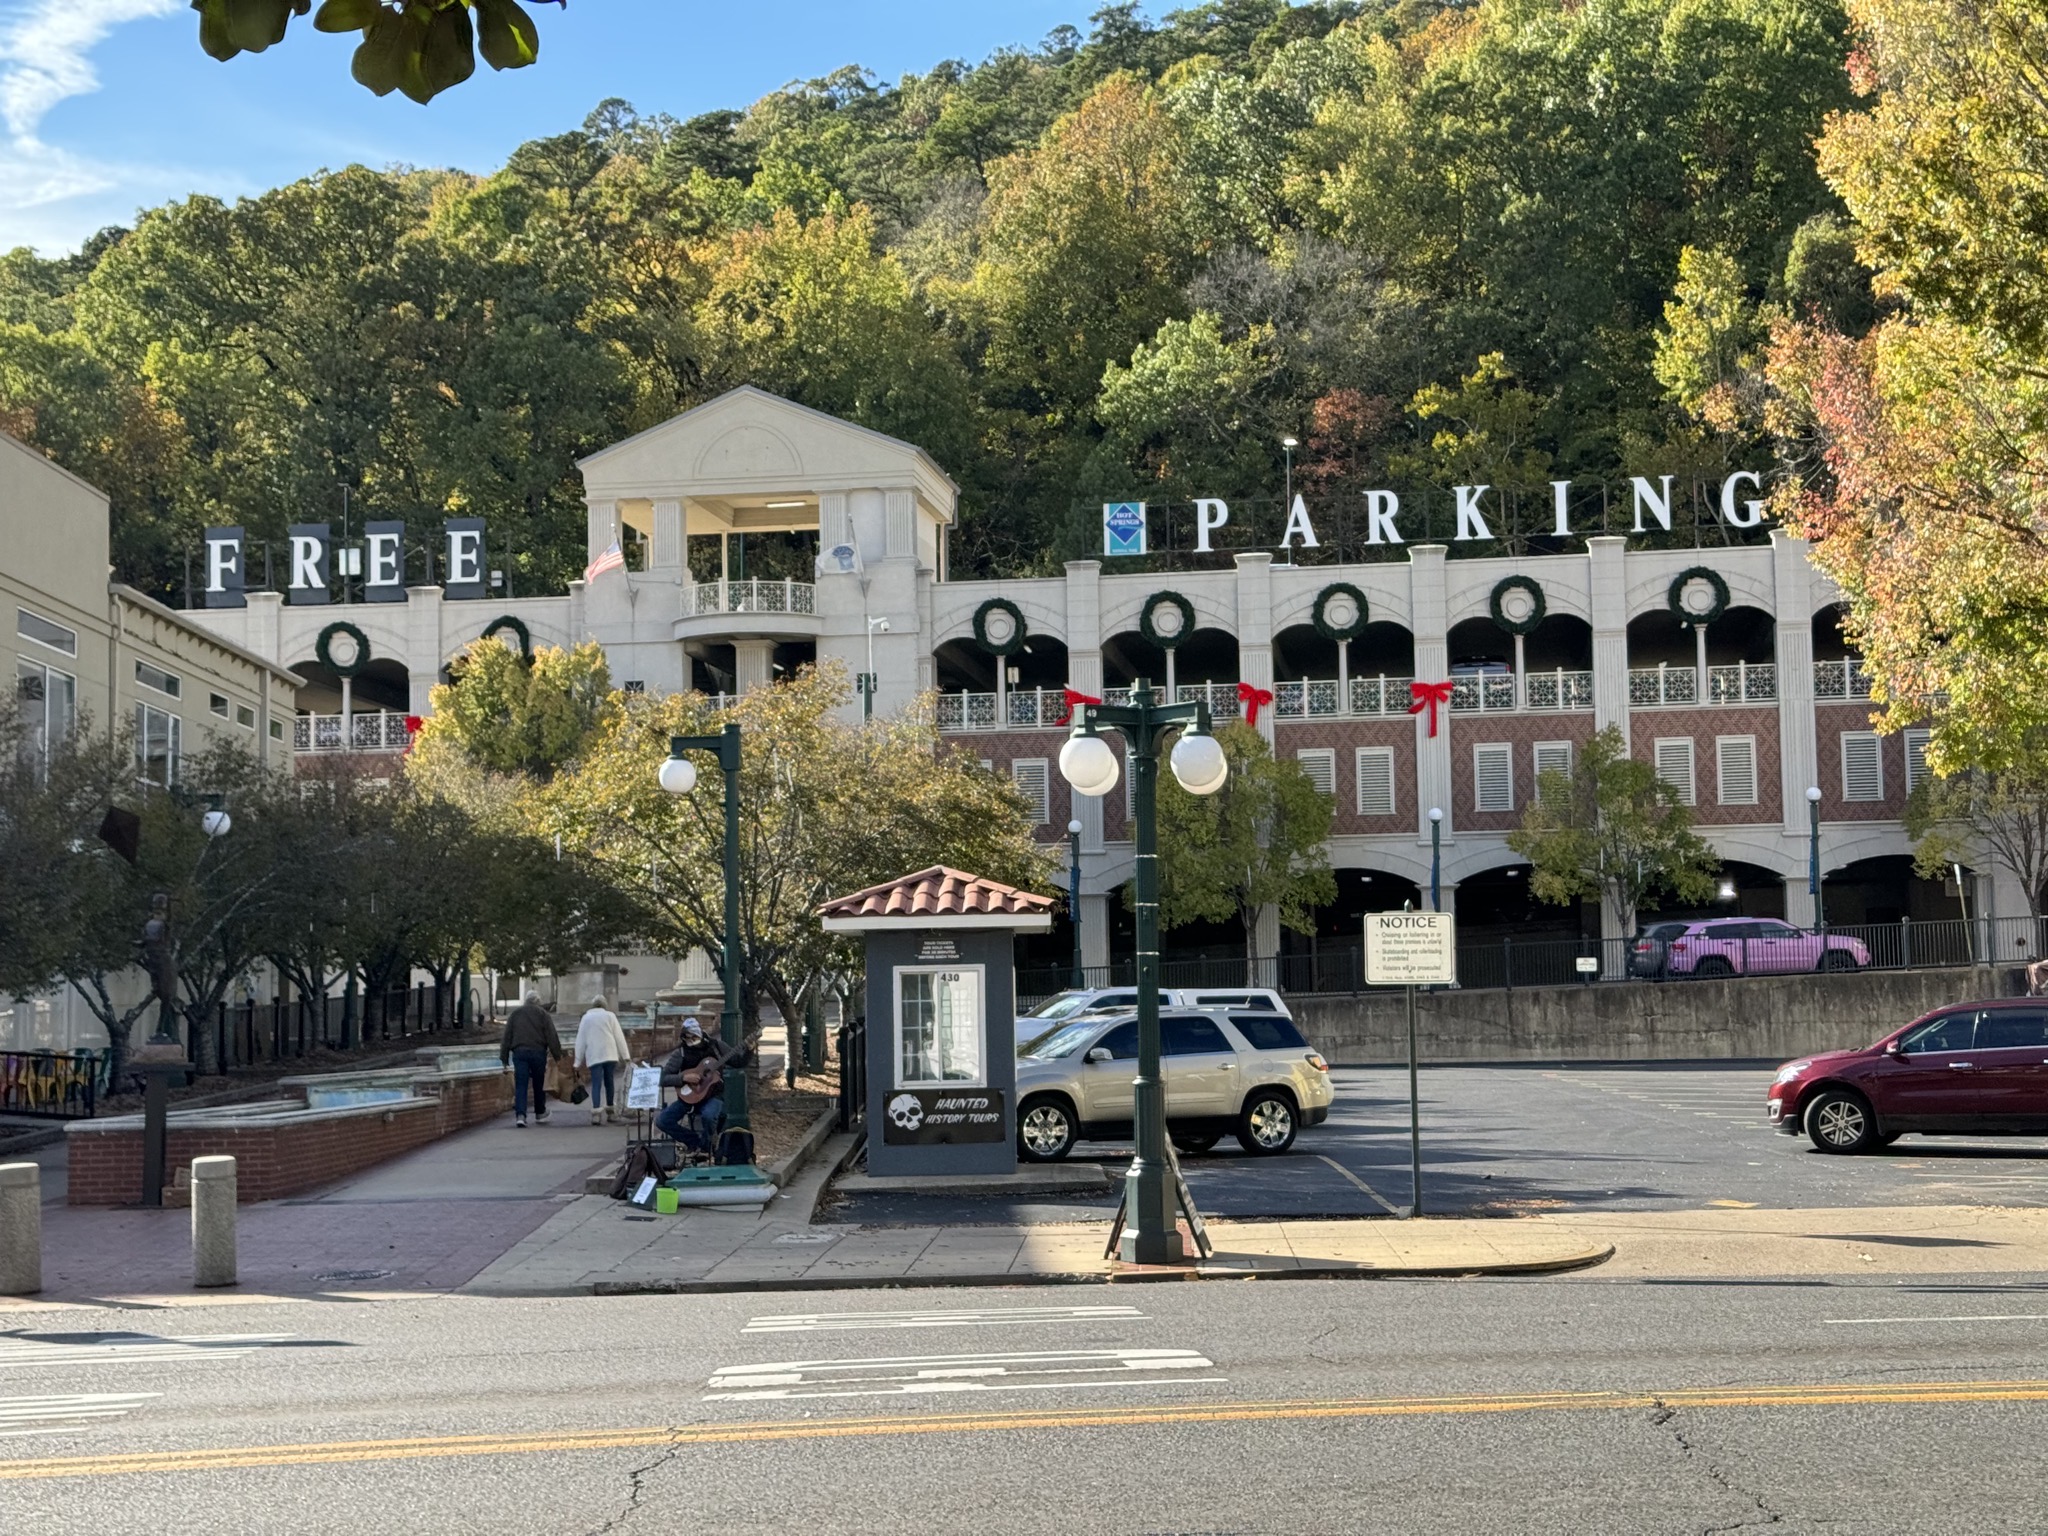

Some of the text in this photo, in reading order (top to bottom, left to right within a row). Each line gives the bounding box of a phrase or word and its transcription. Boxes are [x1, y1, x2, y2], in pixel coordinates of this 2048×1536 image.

[1191, 470, 1766, 553] PARKING
[205, 530, 481, 593] FREE
[1086, 709, 1097, 718] 49
[1380, 917, 1437, 928] NOTICE
[940, 973, 960, 982] 430
[934, 1097, 989, 1110] HAUNTED
[925, 1112, 1000, 1124] HISTORY TOURS
